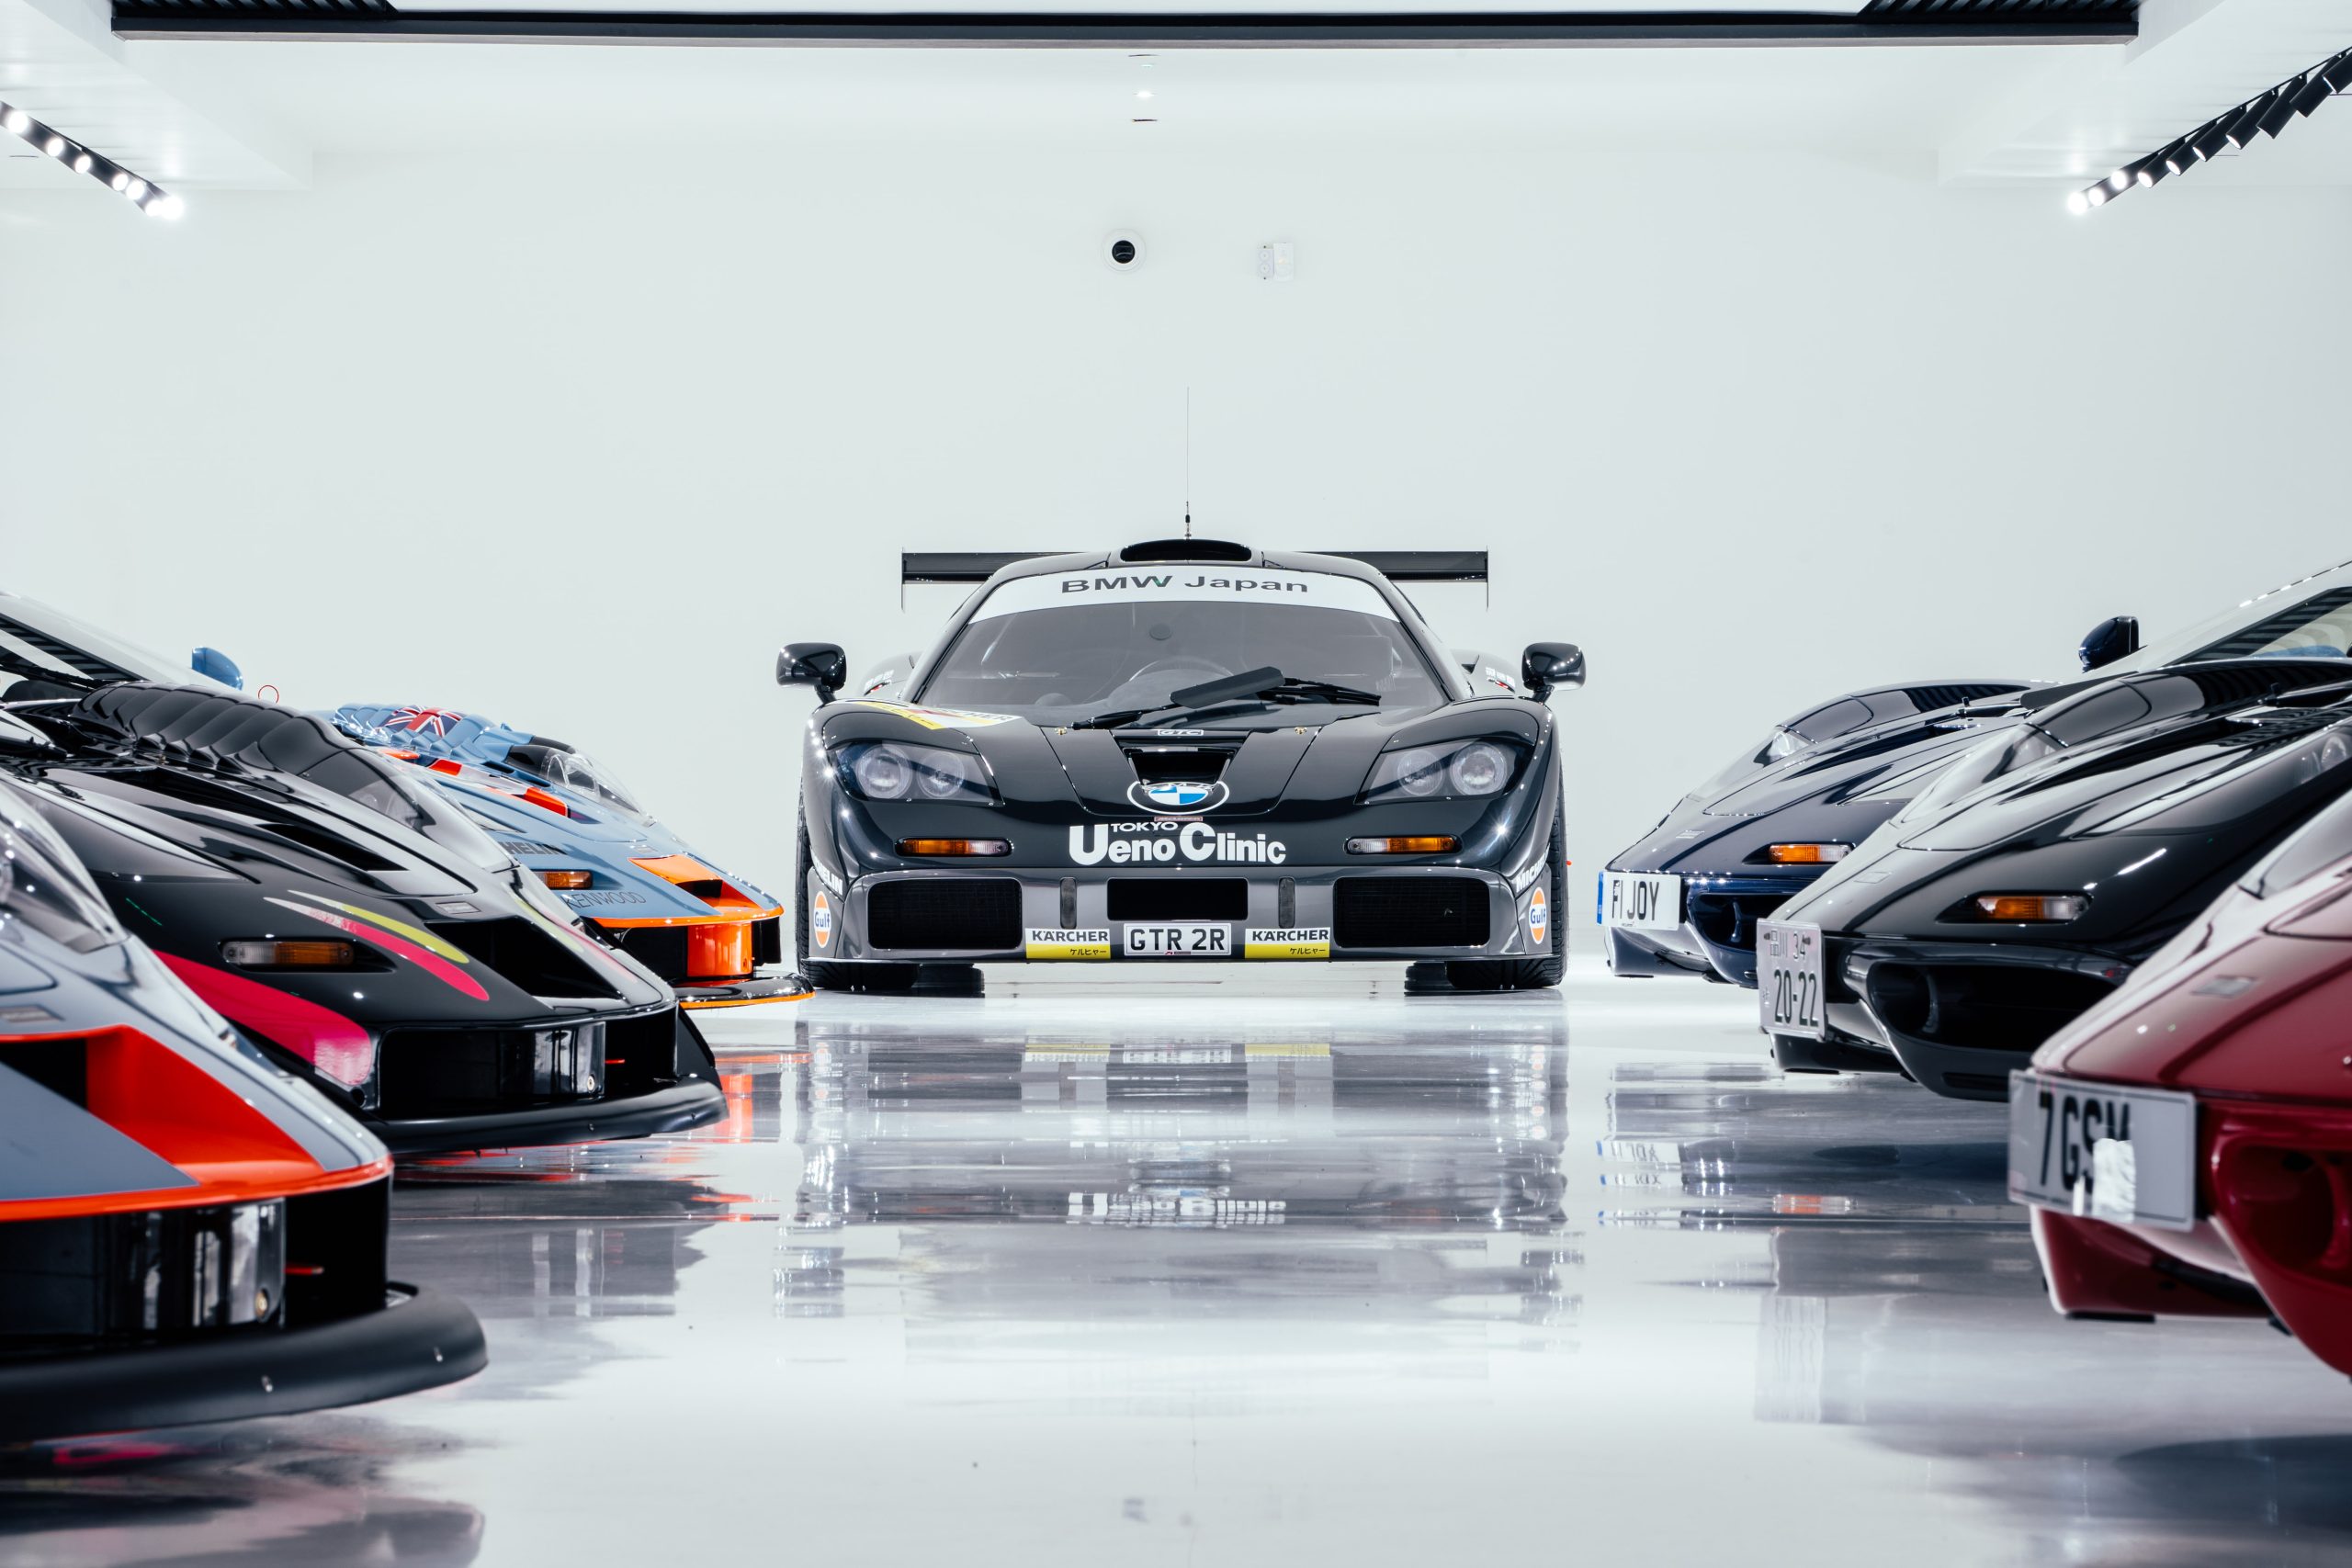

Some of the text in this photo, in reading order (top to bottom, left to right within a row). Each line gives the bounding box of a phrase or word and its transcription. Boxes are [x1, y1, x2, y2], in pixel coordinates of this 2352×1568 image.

[1061, 575, 1308, 593] BMW Japan
[1110, 821, 1179, 833] TOKYO
[1069, 822, 1286, 865] Ueno Clinic
[560, 891, 647, 910] KENWOOD
[1627, 880, 1660, 921] JOY
[814, 911, 831, 928] Gulf
[1530, 908, 1546, 925] Gulf
[1032, 930, 1109, 942] KÄRCHER
[1130, 928, 1225, 951] GTR 2R
[1252, 929, 1329, 942] KÄRCHER
[1773, 968, 1819, 1027] 20-22
